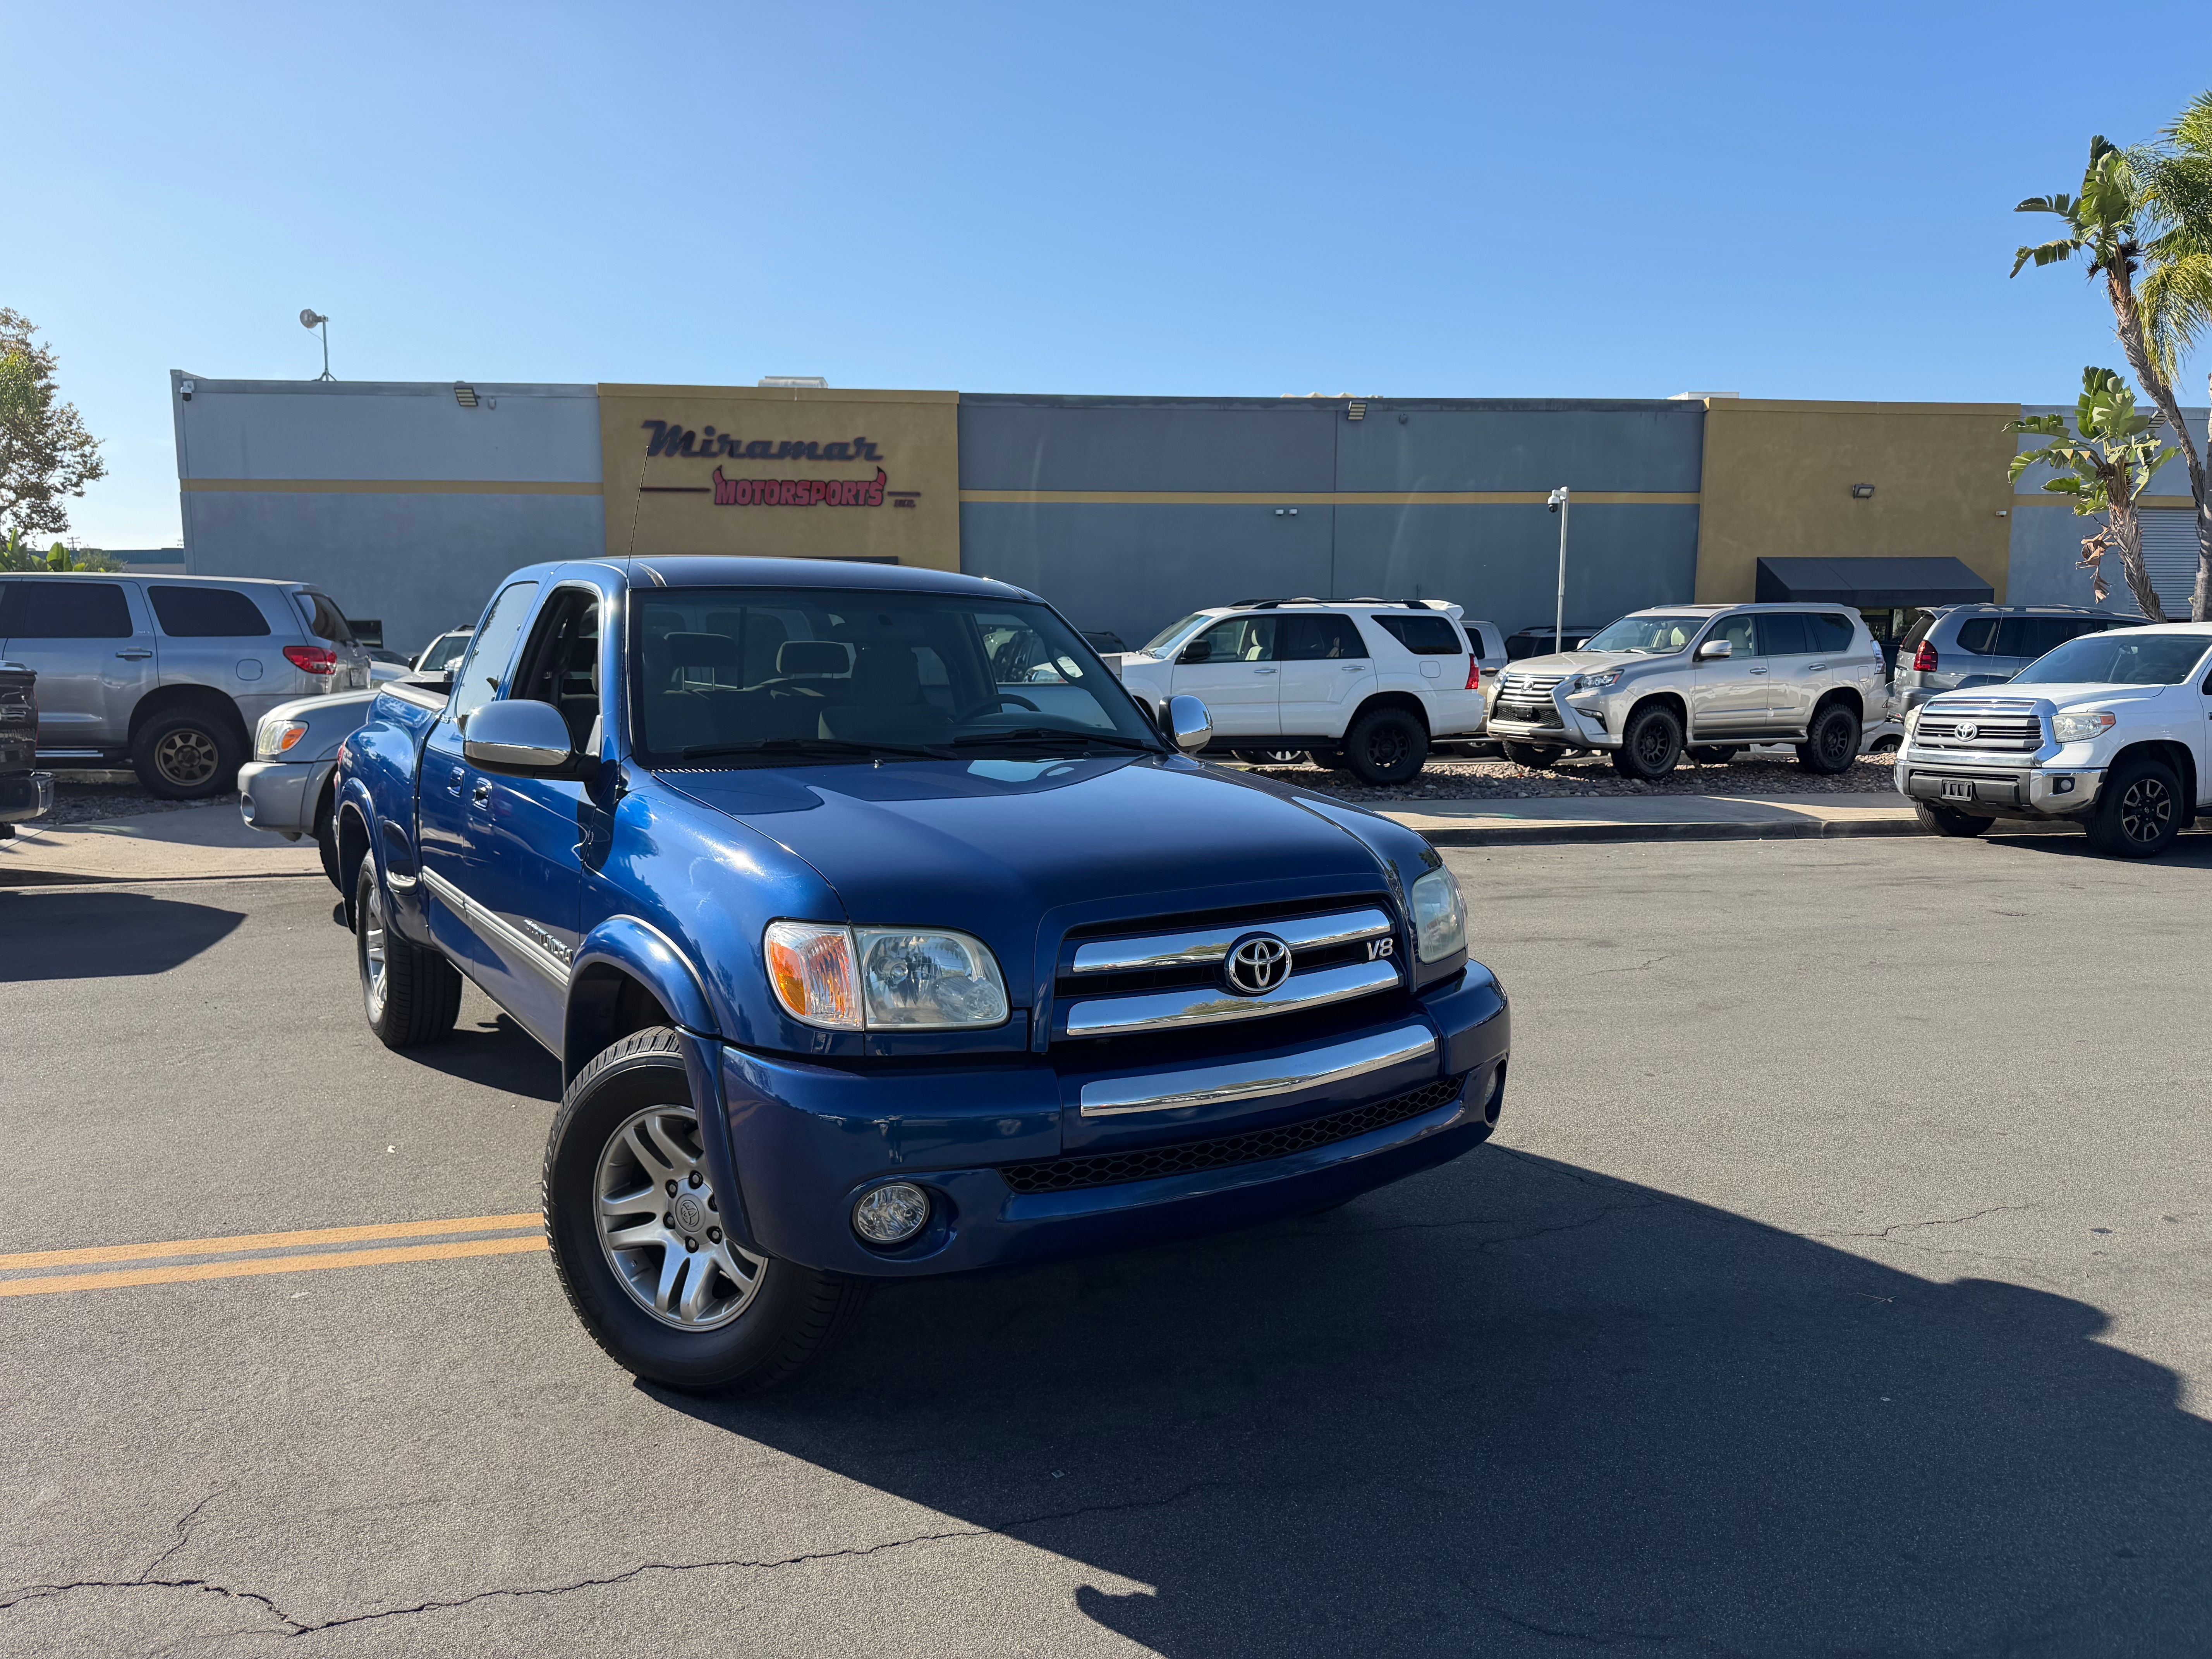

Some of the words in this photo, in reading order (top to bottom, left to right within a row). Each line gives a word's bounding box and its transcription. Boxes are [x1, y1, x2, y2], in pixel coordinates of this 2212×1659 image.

[641, 420, 884, 461] Miramar
[714, 479, 884, 506] MOTORSPORTS
[538, 928, 573, 965] TUNDRA
[1367, 938, 1393, 960] V8
